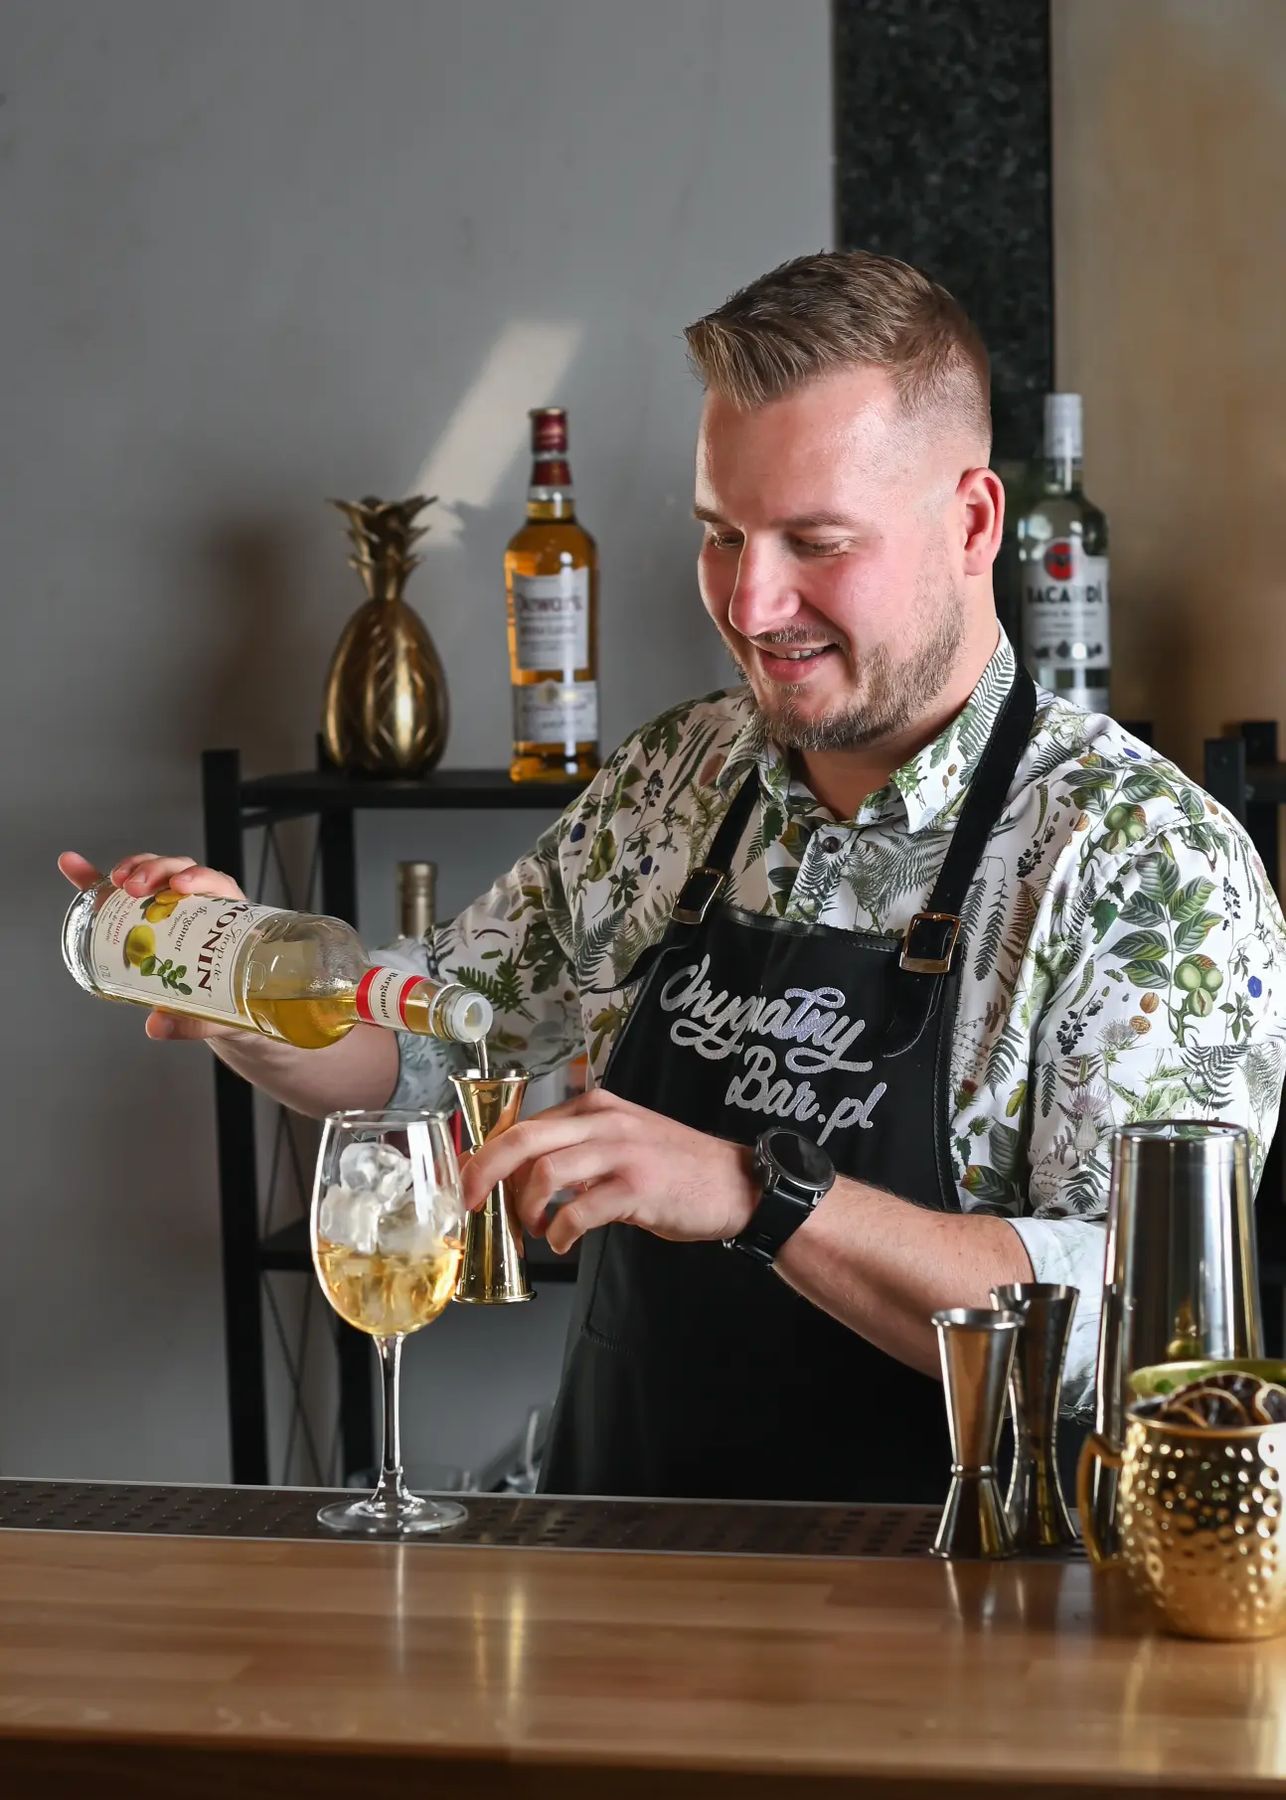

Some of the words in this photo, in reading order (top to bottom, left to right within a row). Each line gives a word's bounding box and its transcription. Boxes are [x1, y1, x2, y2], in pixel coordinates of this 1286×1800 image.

[174, 905, 207, 952] Bergamot
[380, 972, 399, 1019] Bergamot
[724, 1045, 887, 1146] Bar.pl
